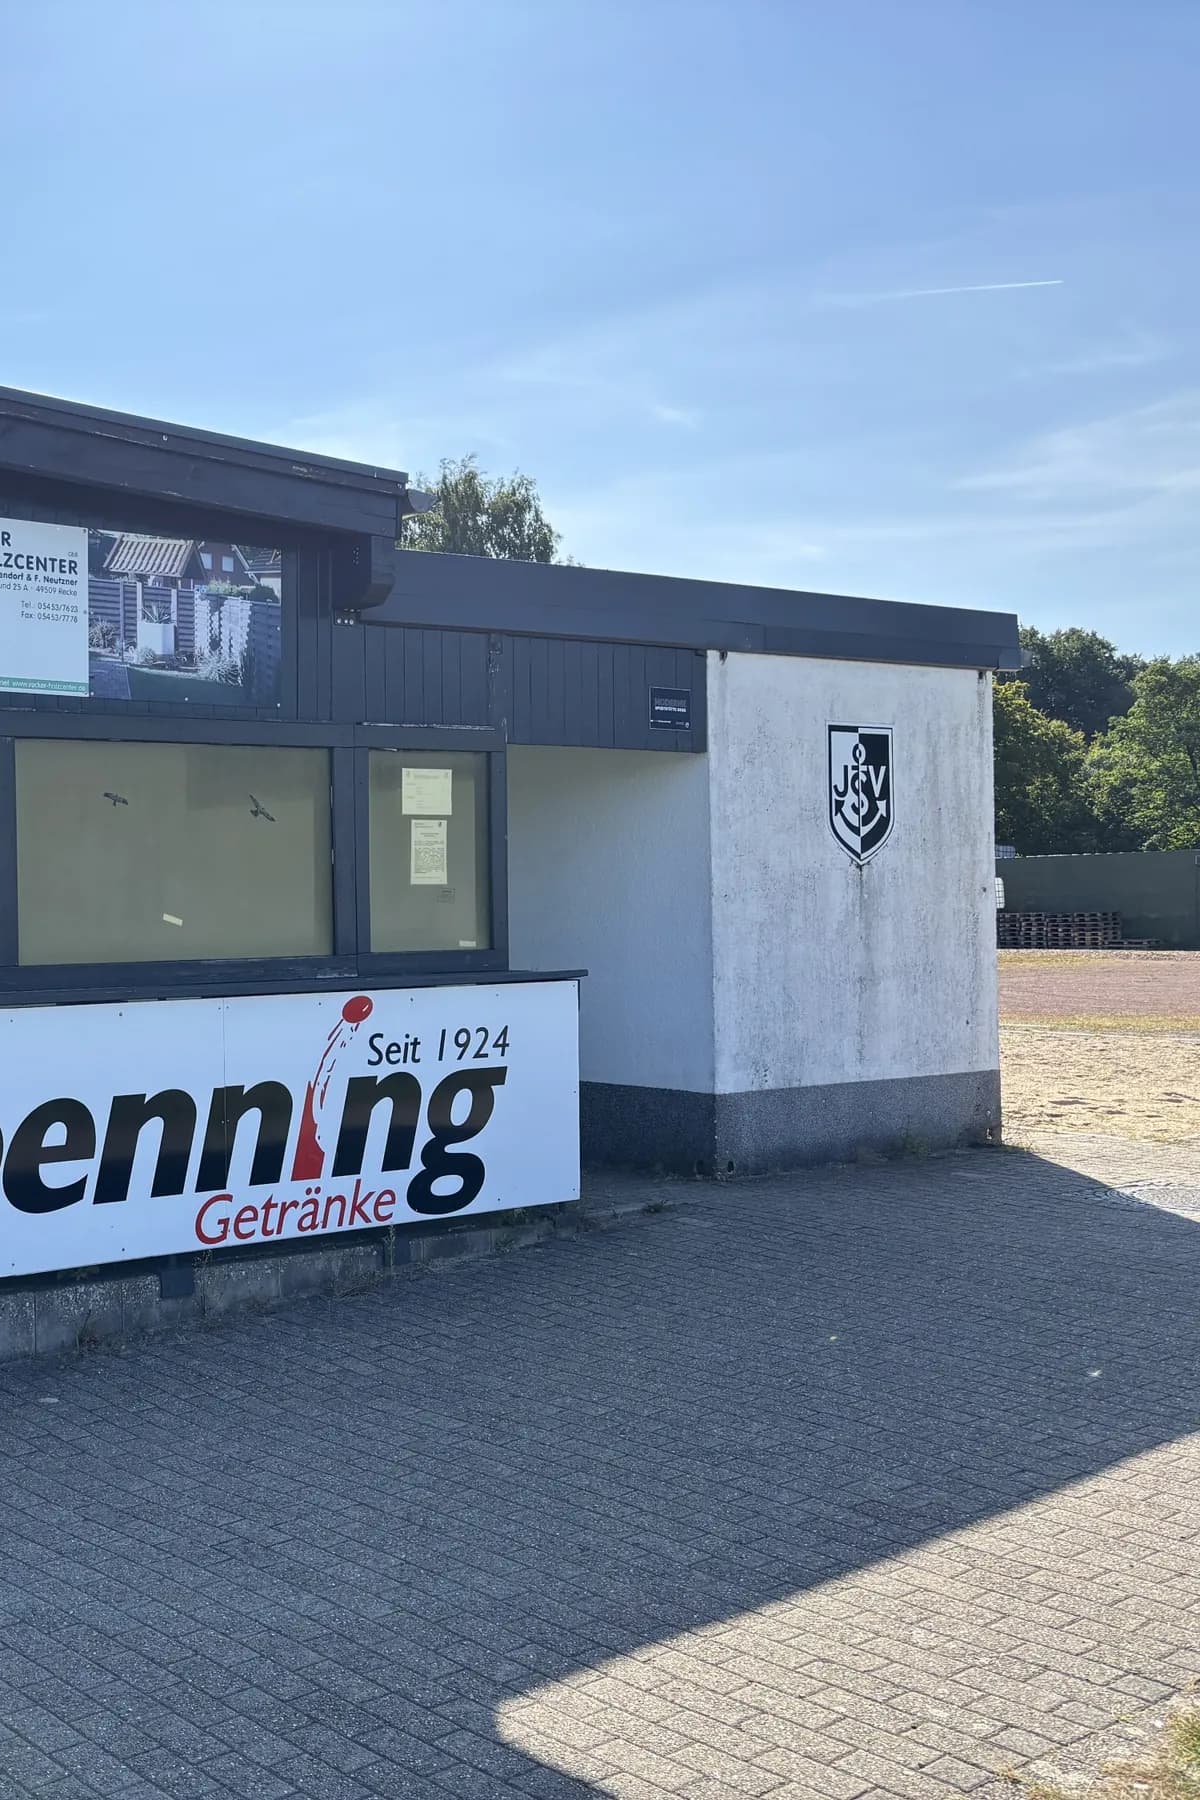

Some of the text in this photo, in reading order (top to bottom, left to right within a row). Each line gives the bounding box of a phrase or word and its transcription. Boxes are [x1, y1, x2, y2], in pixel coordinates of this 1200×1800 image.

[26, 573, 32, 581] &
[34, 574, 41, 583] F.
[43, 575, 78, 586] Neutzner
[13, 583, 21, 591] 25
[36, 585, 57, 594] 49509
[37, 602, 79, 613] 05453/7623
[367, 1025, 510, 1066] Seit 1924
[195, 1179, 397, 1245] Getränke
